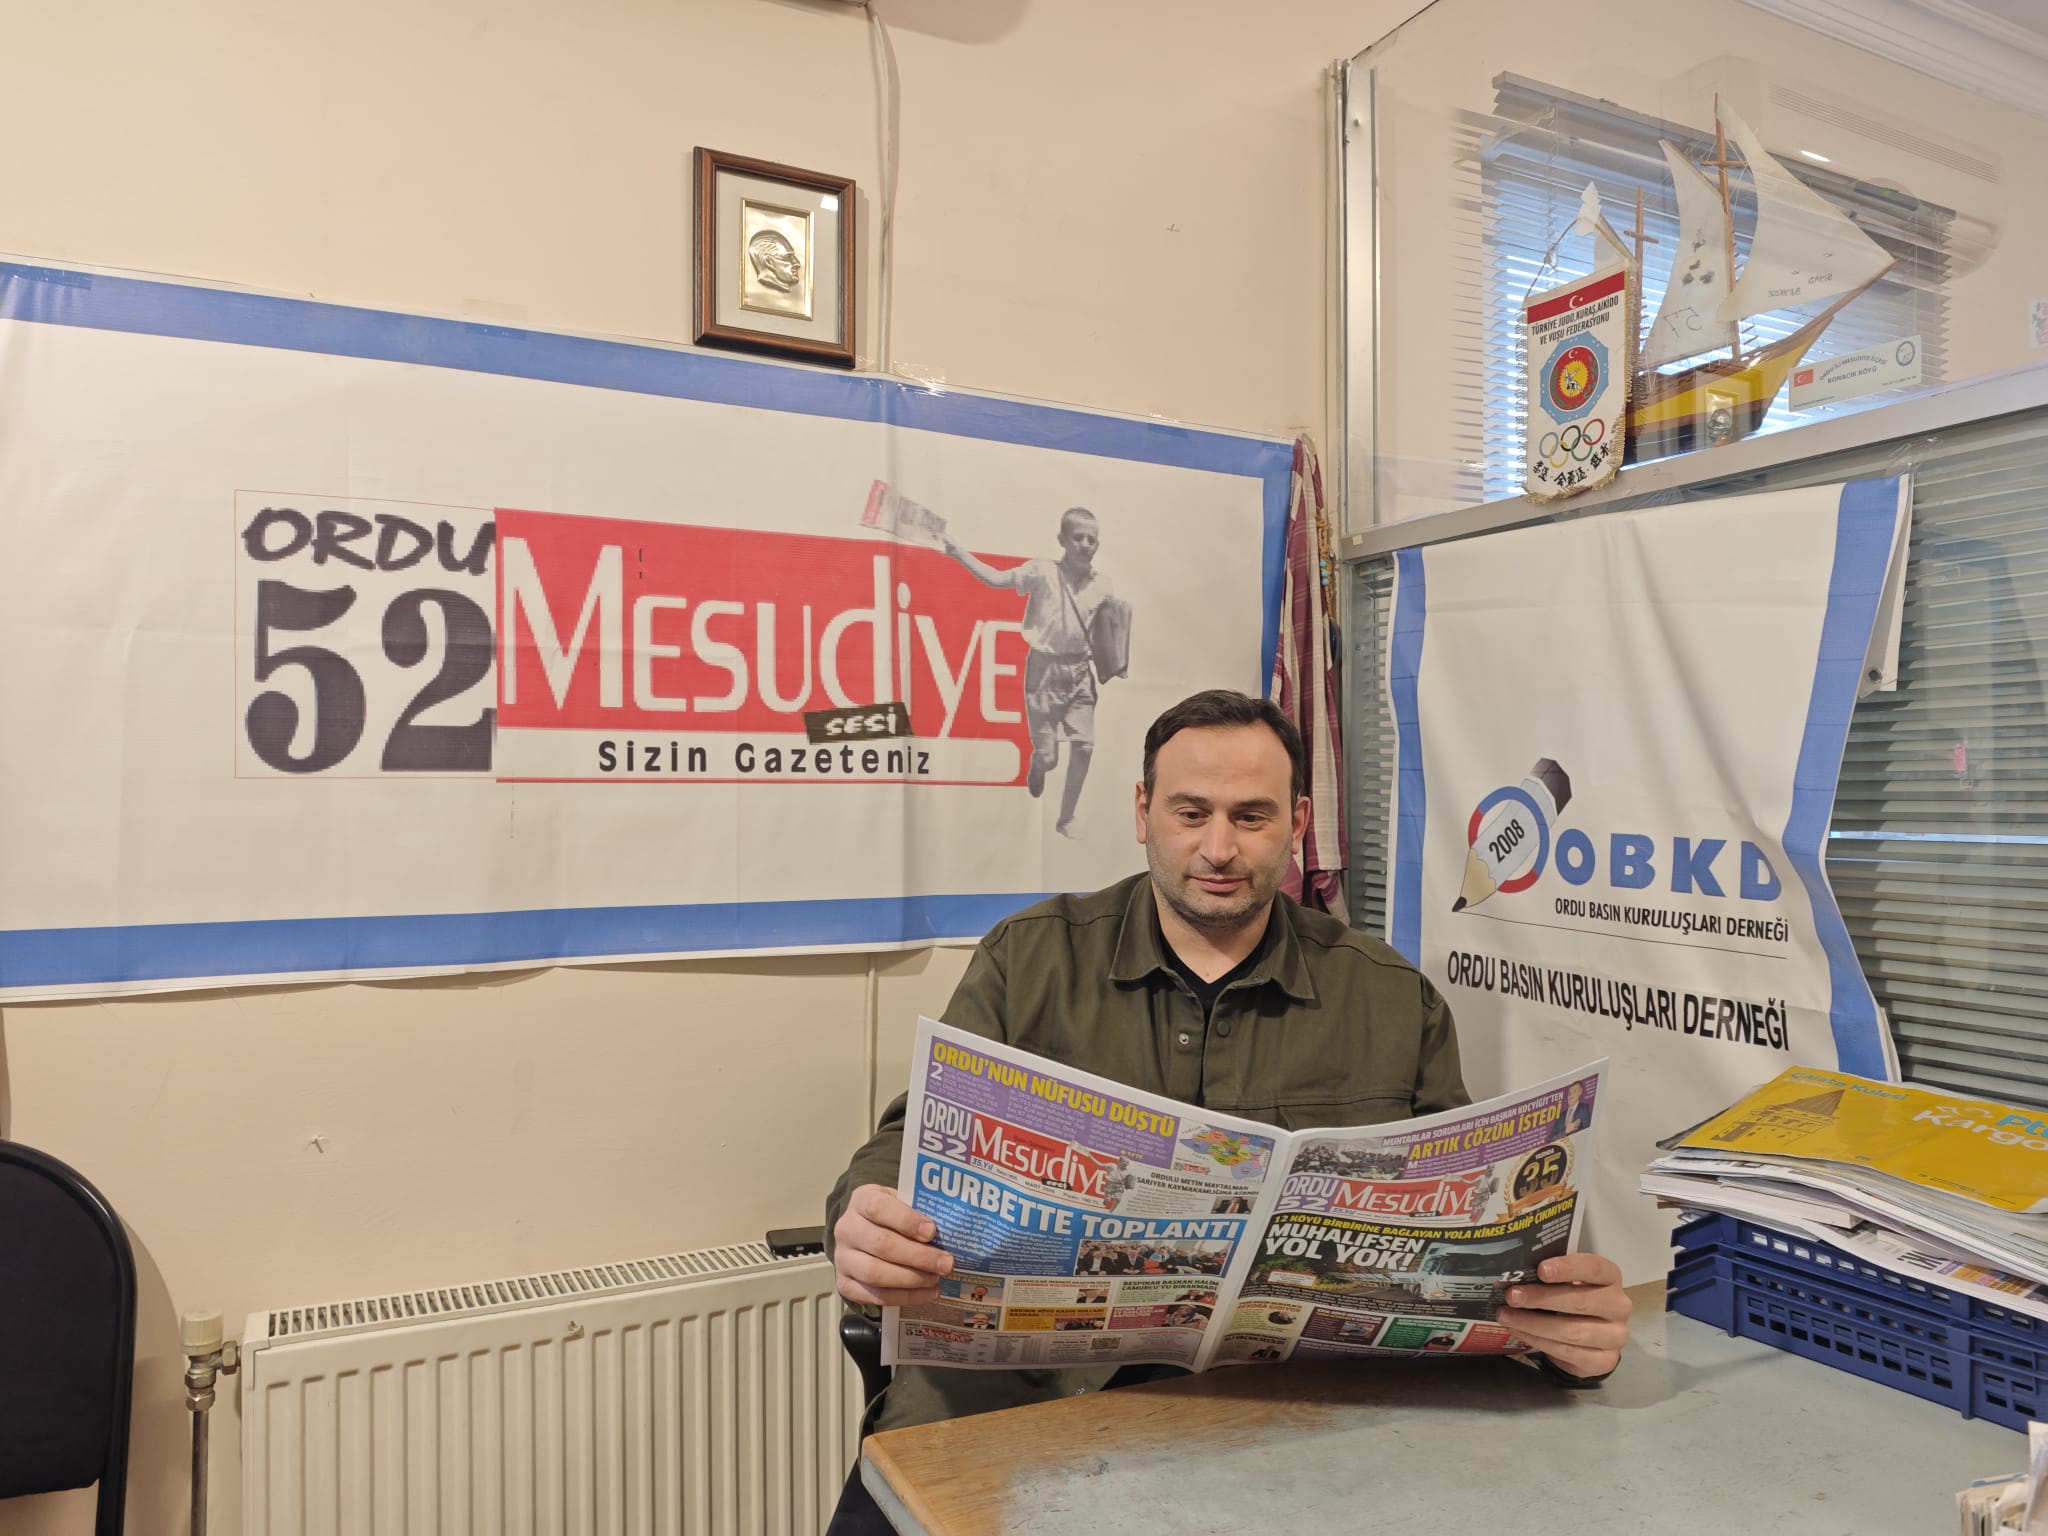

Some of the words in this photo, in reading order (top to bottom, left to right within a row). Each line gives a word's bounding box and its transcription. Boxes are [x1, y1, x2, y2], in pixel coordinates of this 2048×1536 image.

[1540, 334, 1548, 345] VE
[1566, 312, 1610, 336] FEDERASYONU
[241, 507, 497, 576] ORDU
[245, 579, 497, 774] 52
[598, 740, 708, 773] Sizin
[735, 743, 931, 775] Gazeteniz
[1489, 819, 1525, 863] 2008
[1555, 828, 1782, 902] OBKD
[1555, 898, 1586, 918] ORDU
[1589, 902, 1621, 922] BASIN
[1624, 906, 1721, 935] KURULUŞLARI
[1726, 912, 1789, 942] DERNEĞİ
[1448, 951, 1496, 991] ORDU
[1499, 959, 1544, 1003] BASIN
[1547, 969, 1677, 1031] KURULUŞLARI
[1683, 993, 1789, 1051] DERNEĞİ
[933, 1042, 1027, 1091] ORDU'NUN
[1031, 1075, 1105, 1117] NÜFUSU
[1109, 1101, 1175, 1137] DÜŞTÜ
[923, 1098, 973, 1141] ORDU
[1383, 1131, 1431, 1147] MUHTARLAR
[1432, 1121, 1474, 1139] SORUNLARI
[1409, 1134, 1459, 1160] ARTIK
[1464, 1119, 1515, 1150] ÇÖZÜM
[1518, 1103, 1562, 1133] İSTEDİ
[1912, 1110, 2048, 1150] Kargo
[922, 1130, 966, 1161] 52
[1151, 1172, 1179, 1184] ORDULU
[1181, 1175, 1203, 1187] METİN
[1282, 1176, 1339, 1197] ORDU
[1519, 1152, 1561, 1196] 35
[921, 1162, 1073, 1234] GURBETTE
[1276, 1198, 1328, 1211] 52
[1290, 1214, 1321, 1225] KÖYÜ
[1323, 1218, 1381, 1234] BİRBİRİNE
[1382, 1226, 1442, 1239] BAĞLAYAN
[1444, 1228, 1471, 1239] YOLA
[1474, 1223, 1506, 1238] KİMSE
[1506, 1215, 1534, 1234] SAHİP
[1535, 1198, 1574, 1224] ÇIKMIYOR
[1082, 1215, 1240, 1239] TOPLANTI
[1265, 1237, 1323, 1260] YOL
[1336, 1244, 1415, 1271] YOK!
[1499, 1270, 1524, 1282] 12
